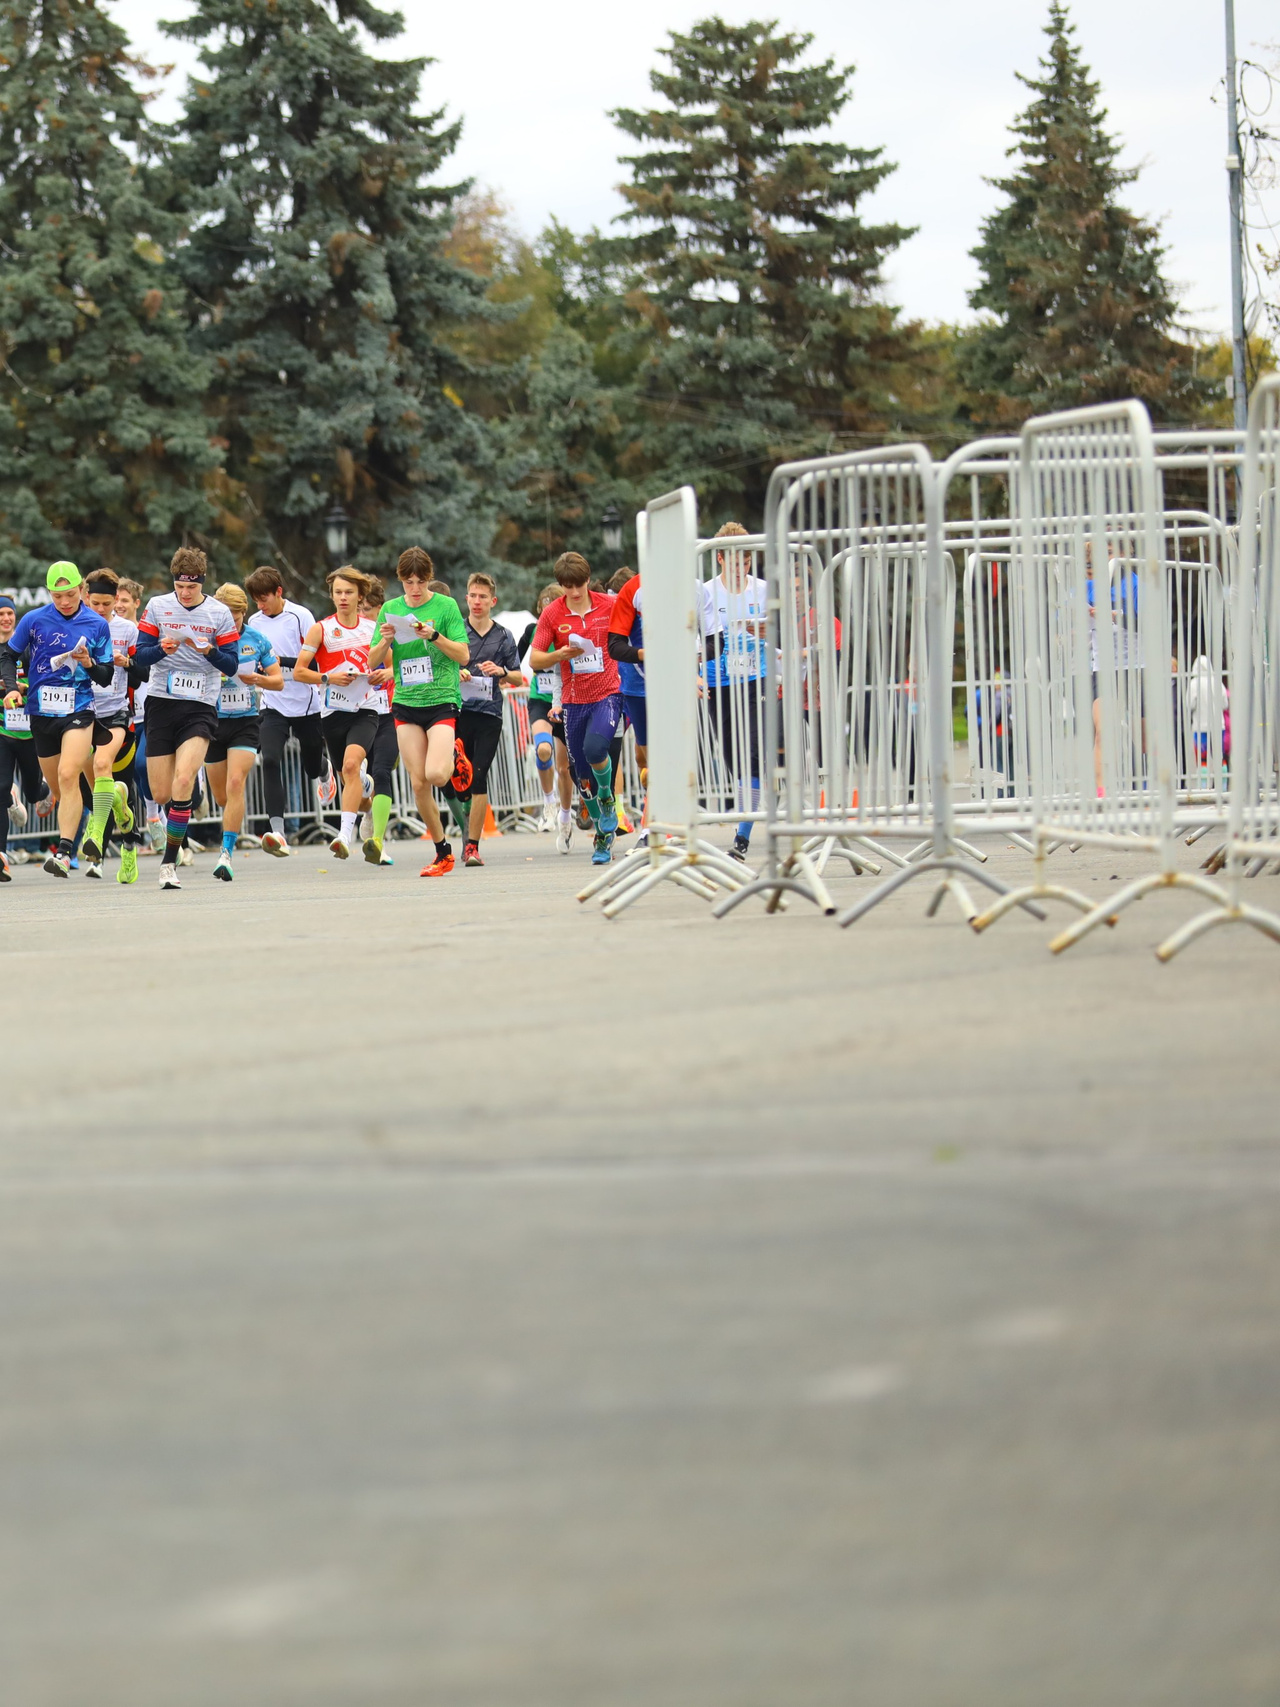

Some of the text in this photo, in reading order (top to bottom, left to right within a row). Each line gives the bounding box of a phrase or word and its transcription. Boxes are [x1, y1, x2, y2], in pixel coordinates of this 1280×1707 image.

[190, 624, 217, 634] WEST
[349, 650, 363, 663] Run
[402, 664, 426, 676] 207.1
[174, 677, 201, 690] 210.1
[42, 691, 69, 703] 219.1
[221, 693, 245, 703] 211.1
[7, 713, 29, 722] 227.1
